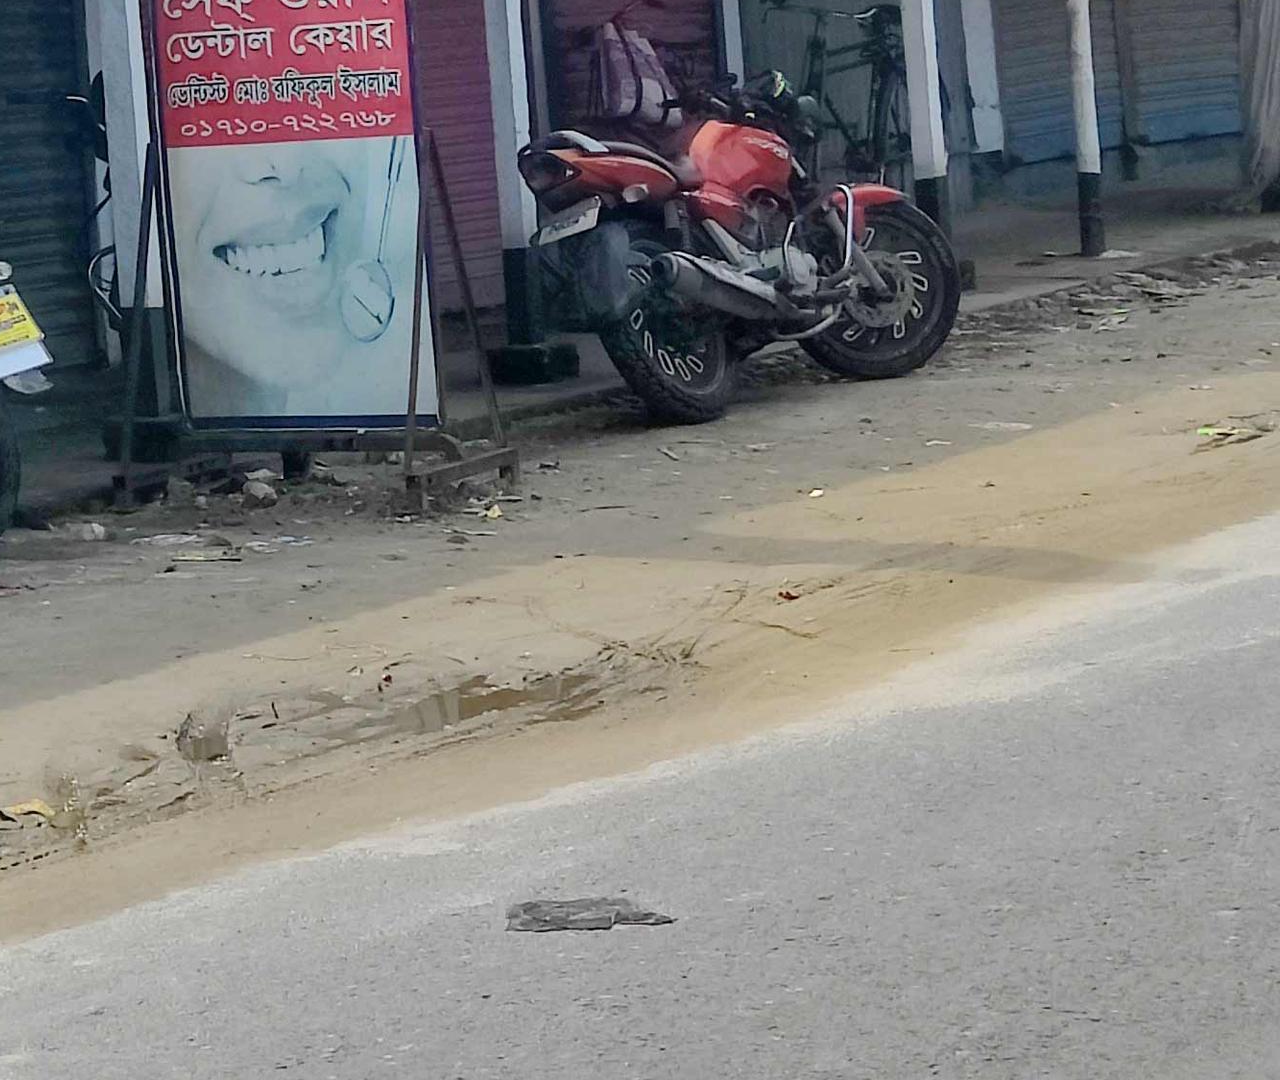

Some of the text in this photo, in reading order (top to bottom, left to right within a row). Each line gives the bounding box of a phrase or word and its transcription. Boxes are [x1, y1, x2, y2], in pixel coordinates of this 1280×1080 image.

[166, 16, 395, 63] ডেন্টাল কেয়ার
[167, 72, 229, 109] ডেন্টিস্ট
[234, 74, 270, 105] মোঃ
[338, 64, 401, 102] ইসলাম
[180, 111, 397, 138] ০১৭১০-৭২২৭৬৮
